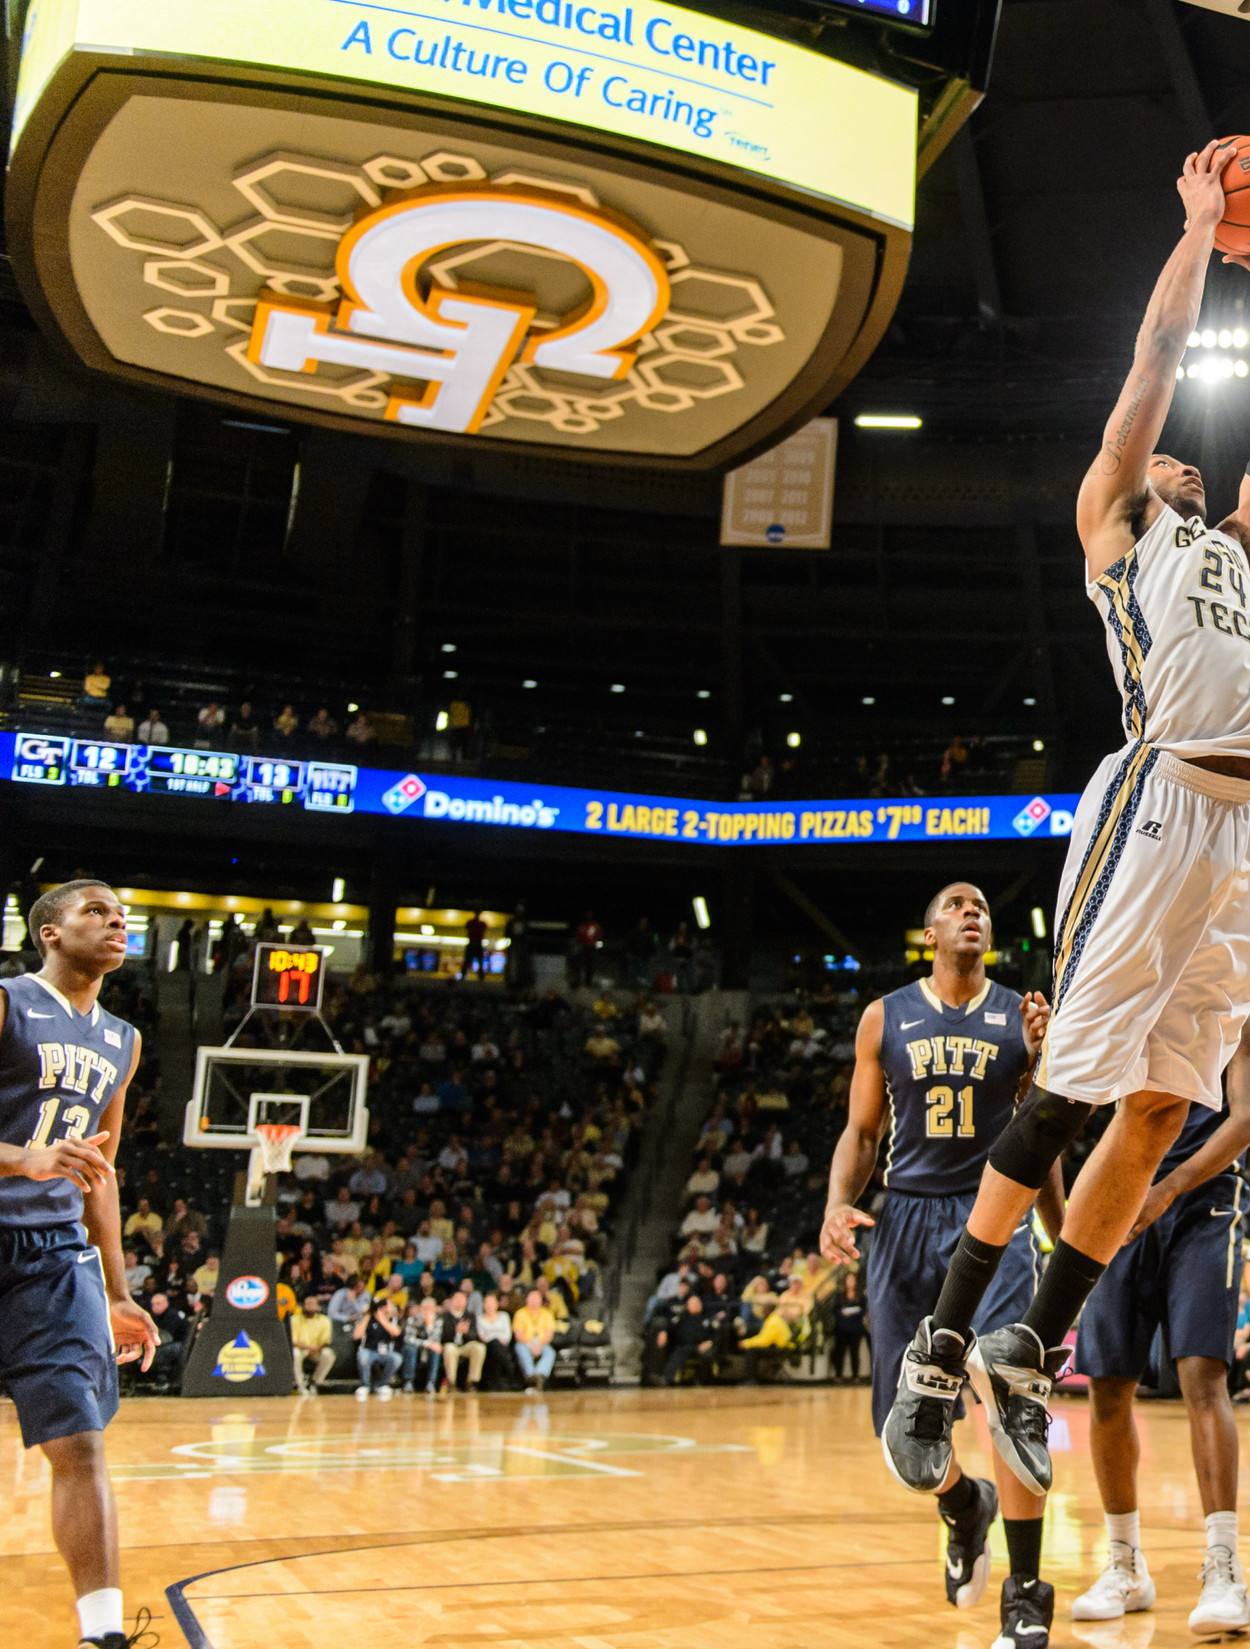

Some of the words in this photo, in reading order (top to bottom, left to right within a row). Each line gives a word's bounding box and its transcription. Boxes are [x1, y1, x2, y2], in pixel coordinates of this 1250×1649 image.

[645, 17, 776, 86] Center
[341, 20, 373, 54] A
[387, 28, 528, 84] Culture
[544, 61, 592, 98] Of
[602, 76, 719, 138] Caring
[1199, 546, 1247, 610] 24
[83, 745, 118, 769] 12
[258, 763, 291, 787] 13
[424, 790, 554, 829] Domino's
[586, 801, 603, 829] 2
[607, 802, 679, 836] LARGE
[682, 810, 795, 842] 2-TOPPING
[800, 810, 874, 839] PIZZAS
[925, 807, 990, 836] EACH!
[269, 950, 319, 974] 10:43
[278, 969, 310, 1005] 17
[37, 1042, 118, 1105] PITT
[906, 1035, 1000, 1081] PITT
[25, 1097, 91, 1150] 13
[926, 1085, 976, 1138] 21
